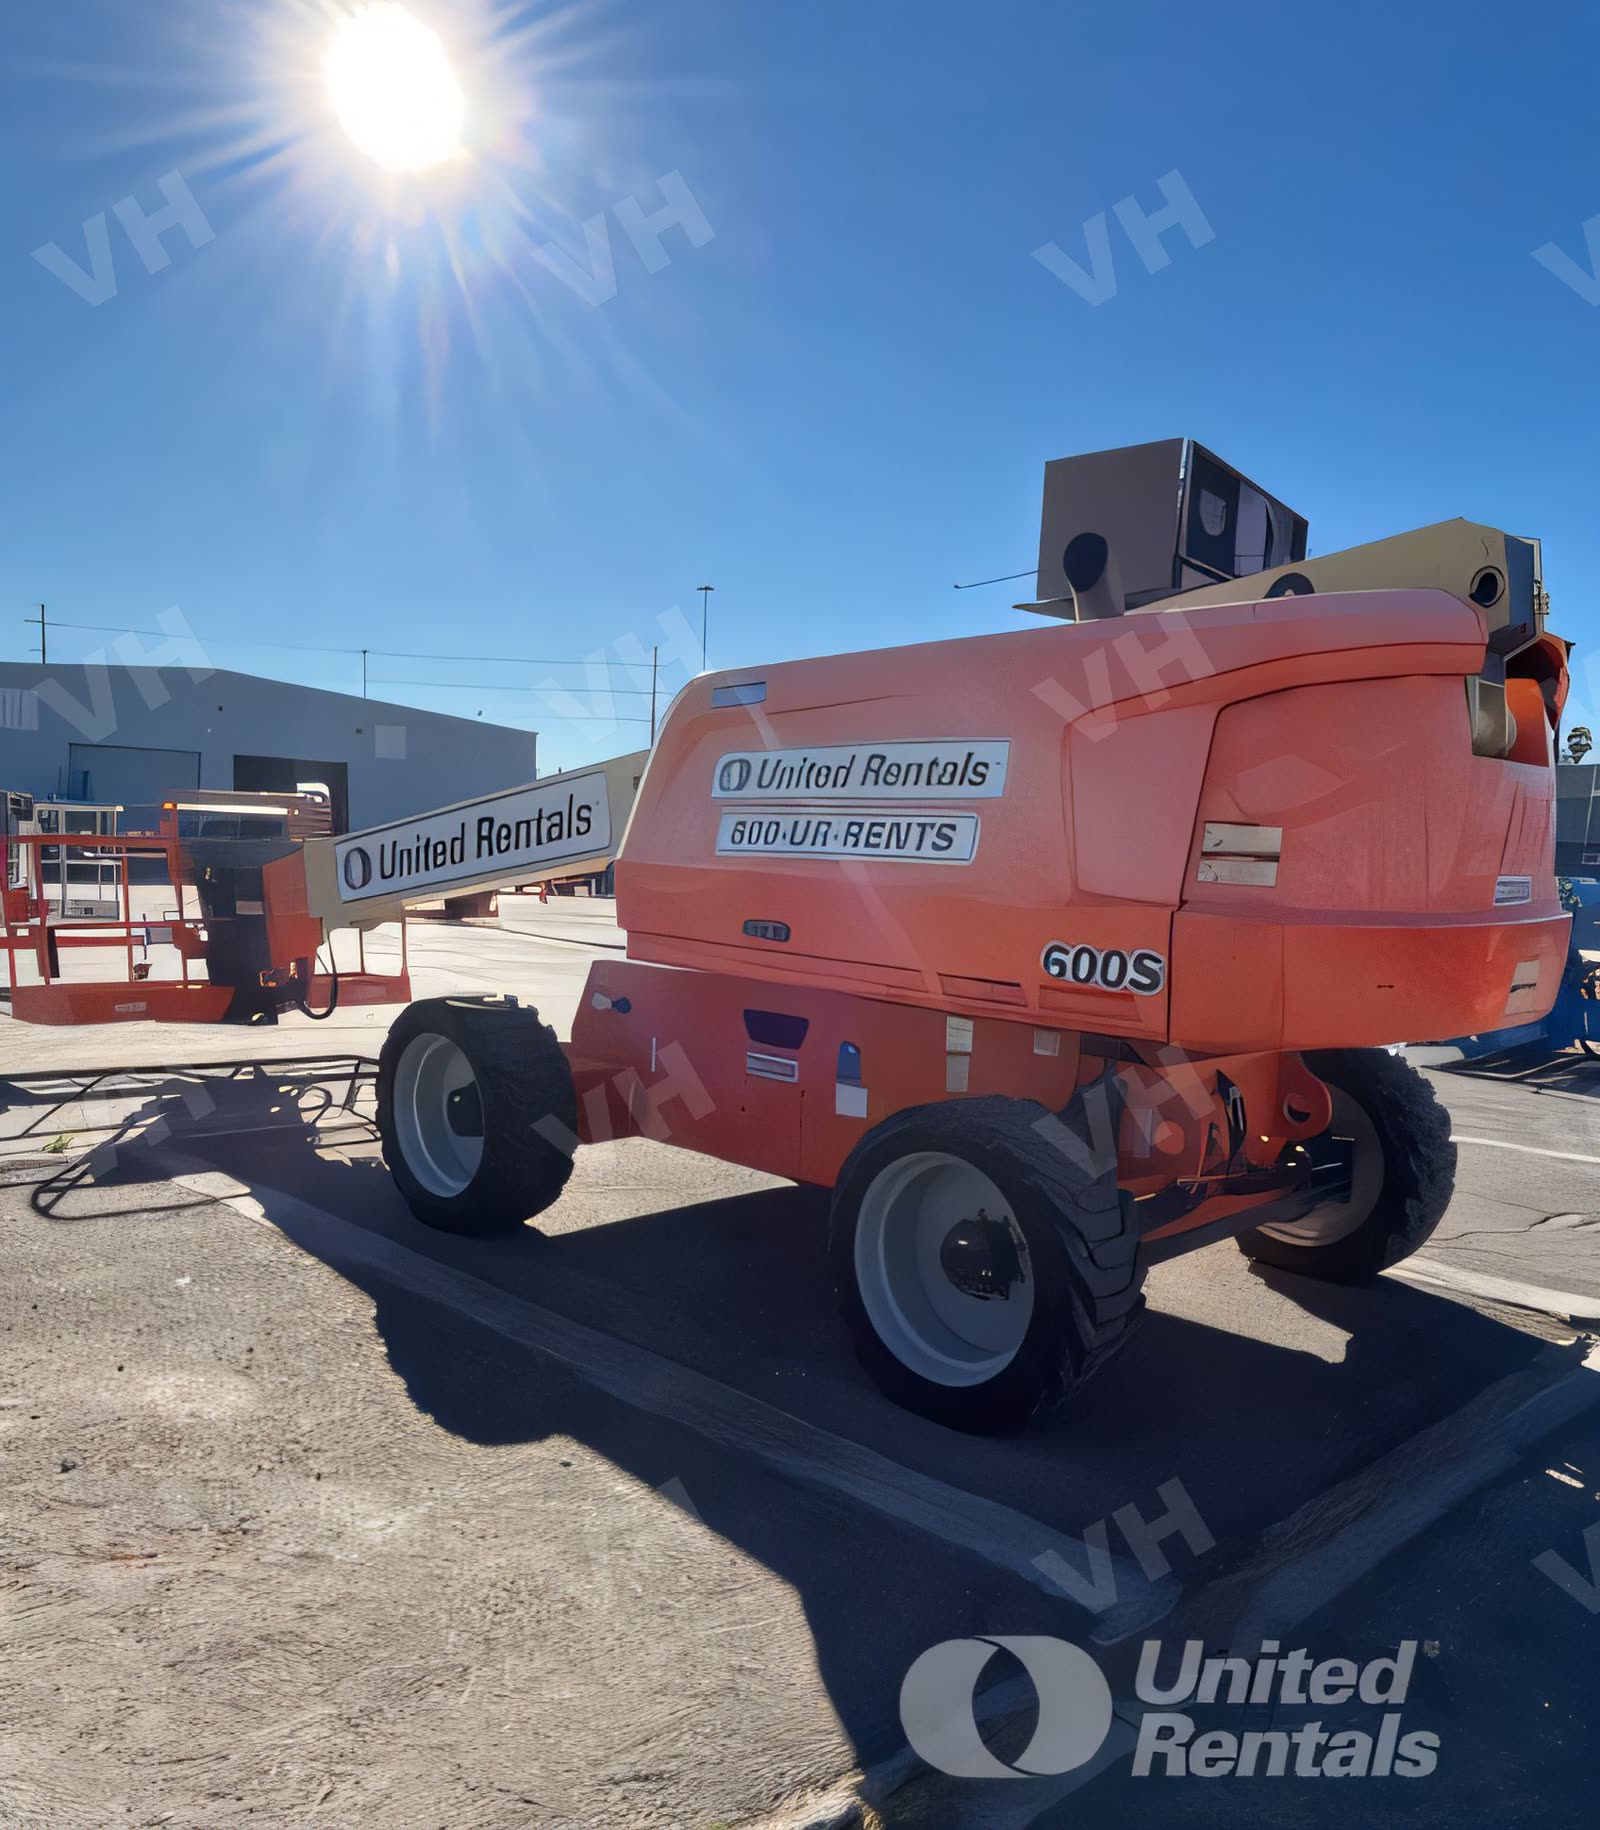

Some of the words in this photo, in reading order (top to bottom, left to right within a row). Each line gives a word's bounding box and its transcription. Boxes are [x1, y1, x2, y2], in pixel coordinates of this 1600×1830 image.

[757, 753, 856, 790] United
[860, 752, 990, 787] Rentals
[379, 821, 466, 880] United
[476, 793, 593, 859] Rentals
[1042, 942, 1164, 994] 600S
